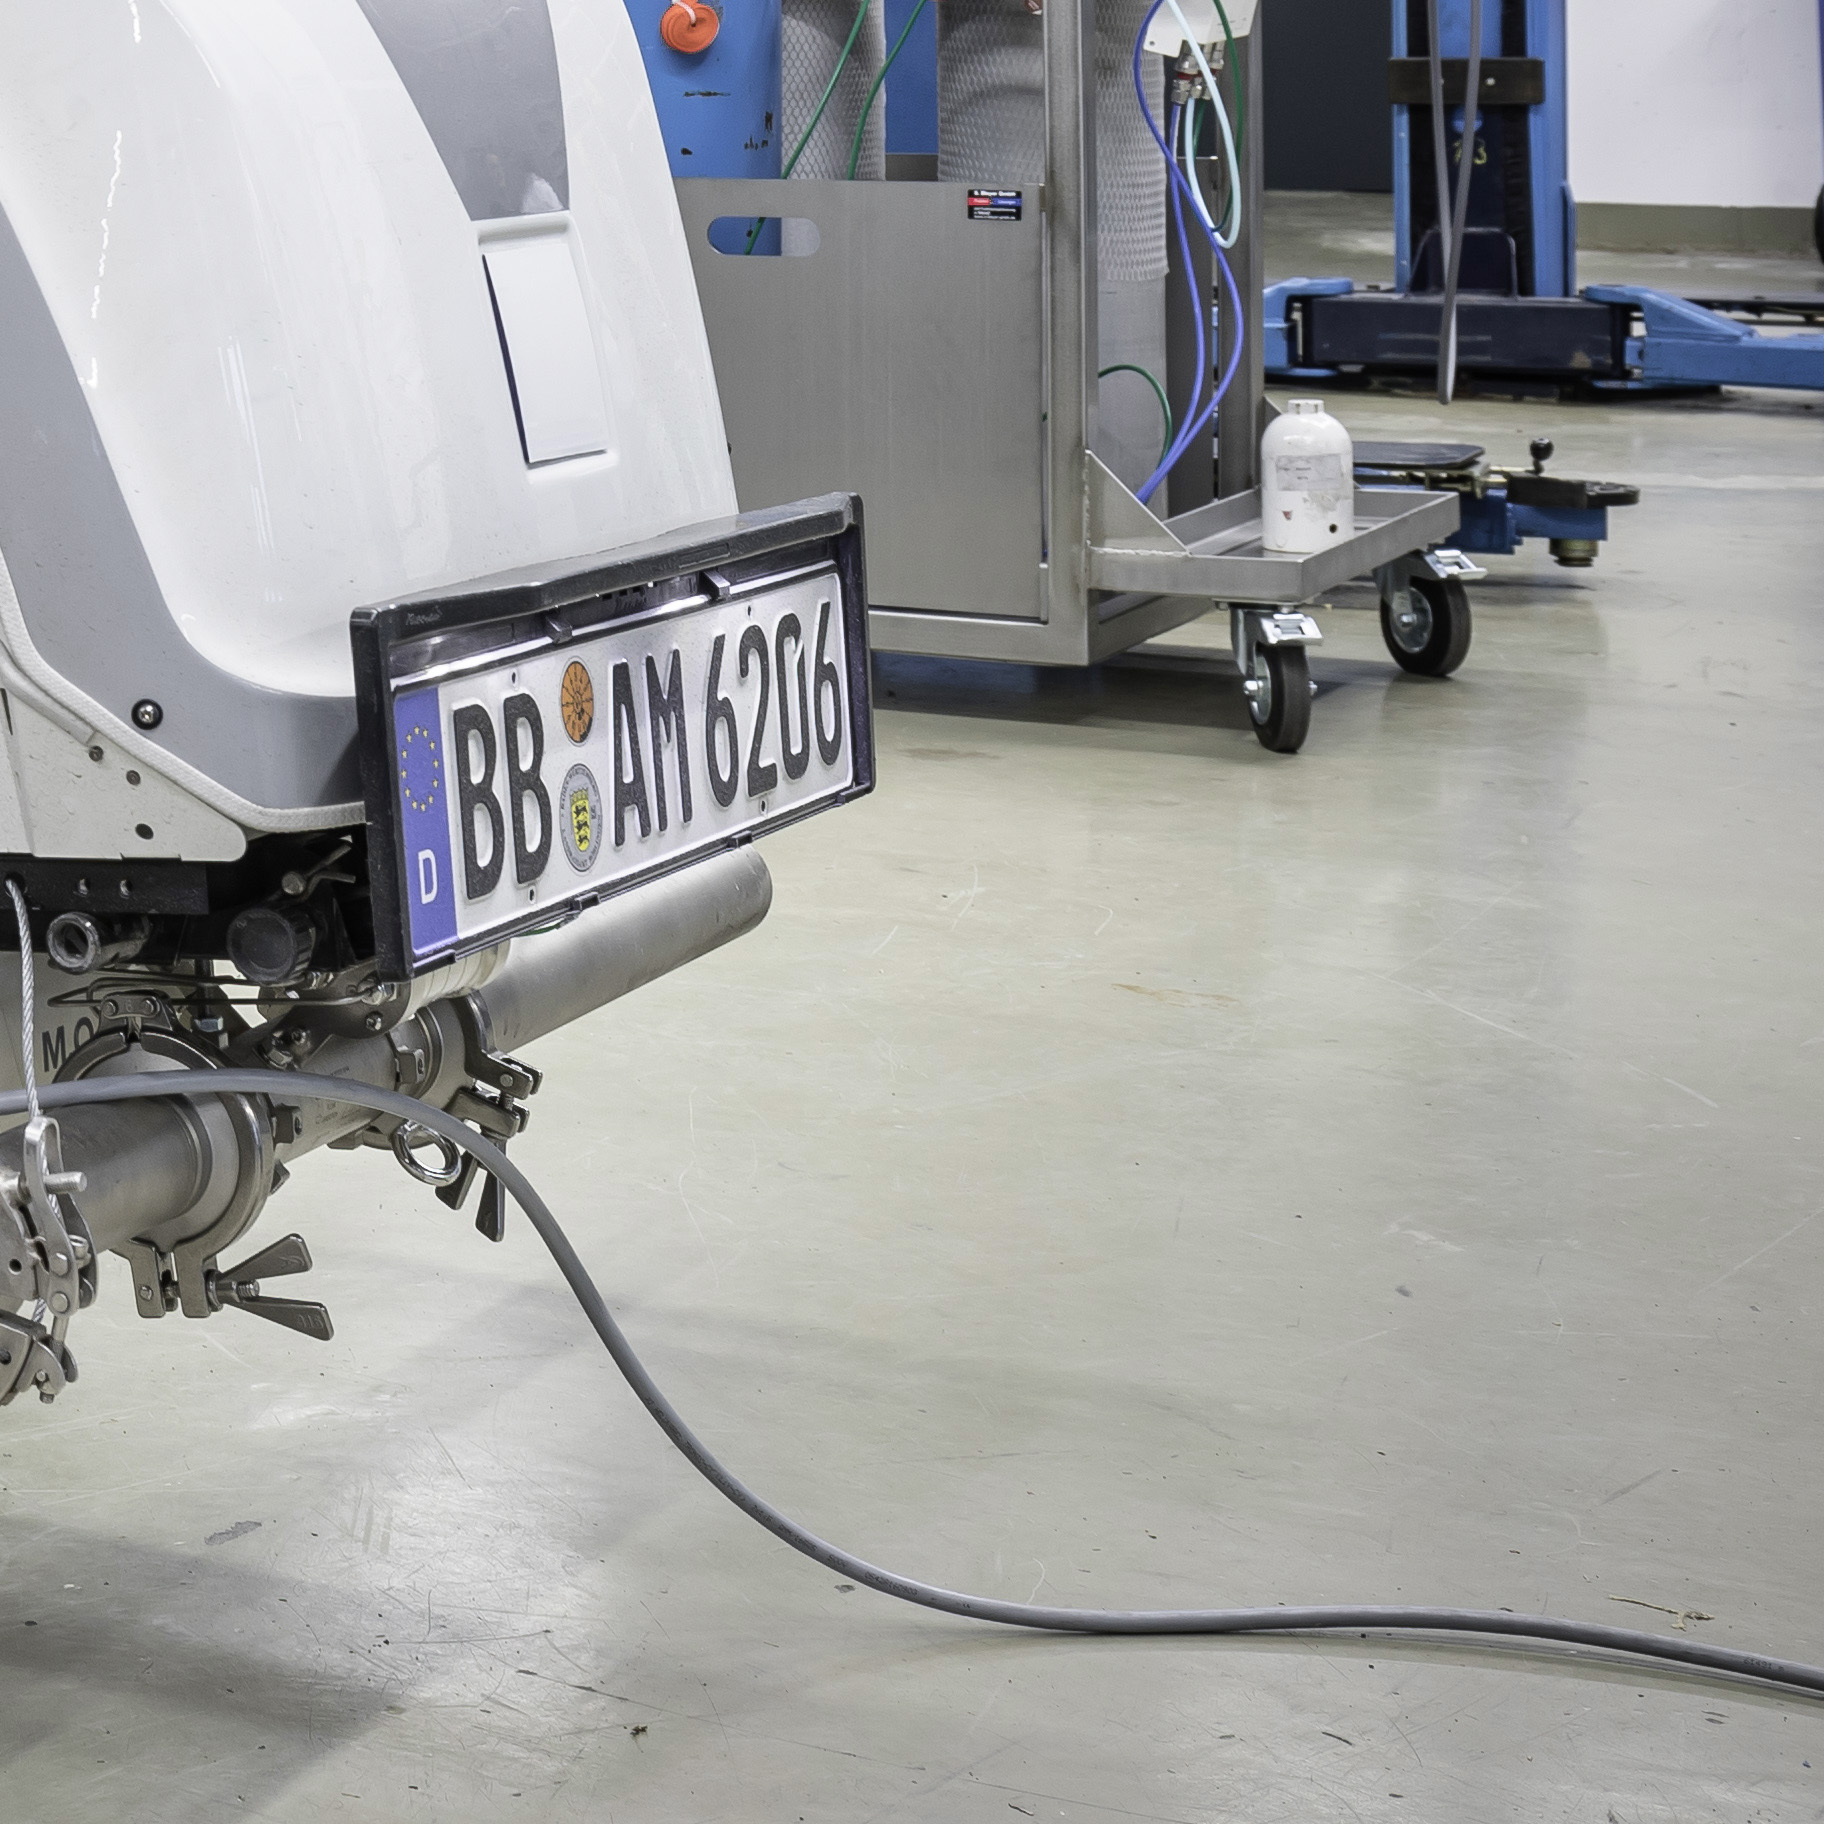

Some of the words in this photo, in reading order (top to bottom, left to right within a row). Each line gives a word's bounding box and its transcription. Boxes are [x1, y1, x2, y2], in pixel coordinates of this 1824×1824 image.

[452, 692, 553, 901] BB
[613, 648, 694, 847] AM
[706, 601, 843, 809] 6206
[418, 849, 438, 905] D
